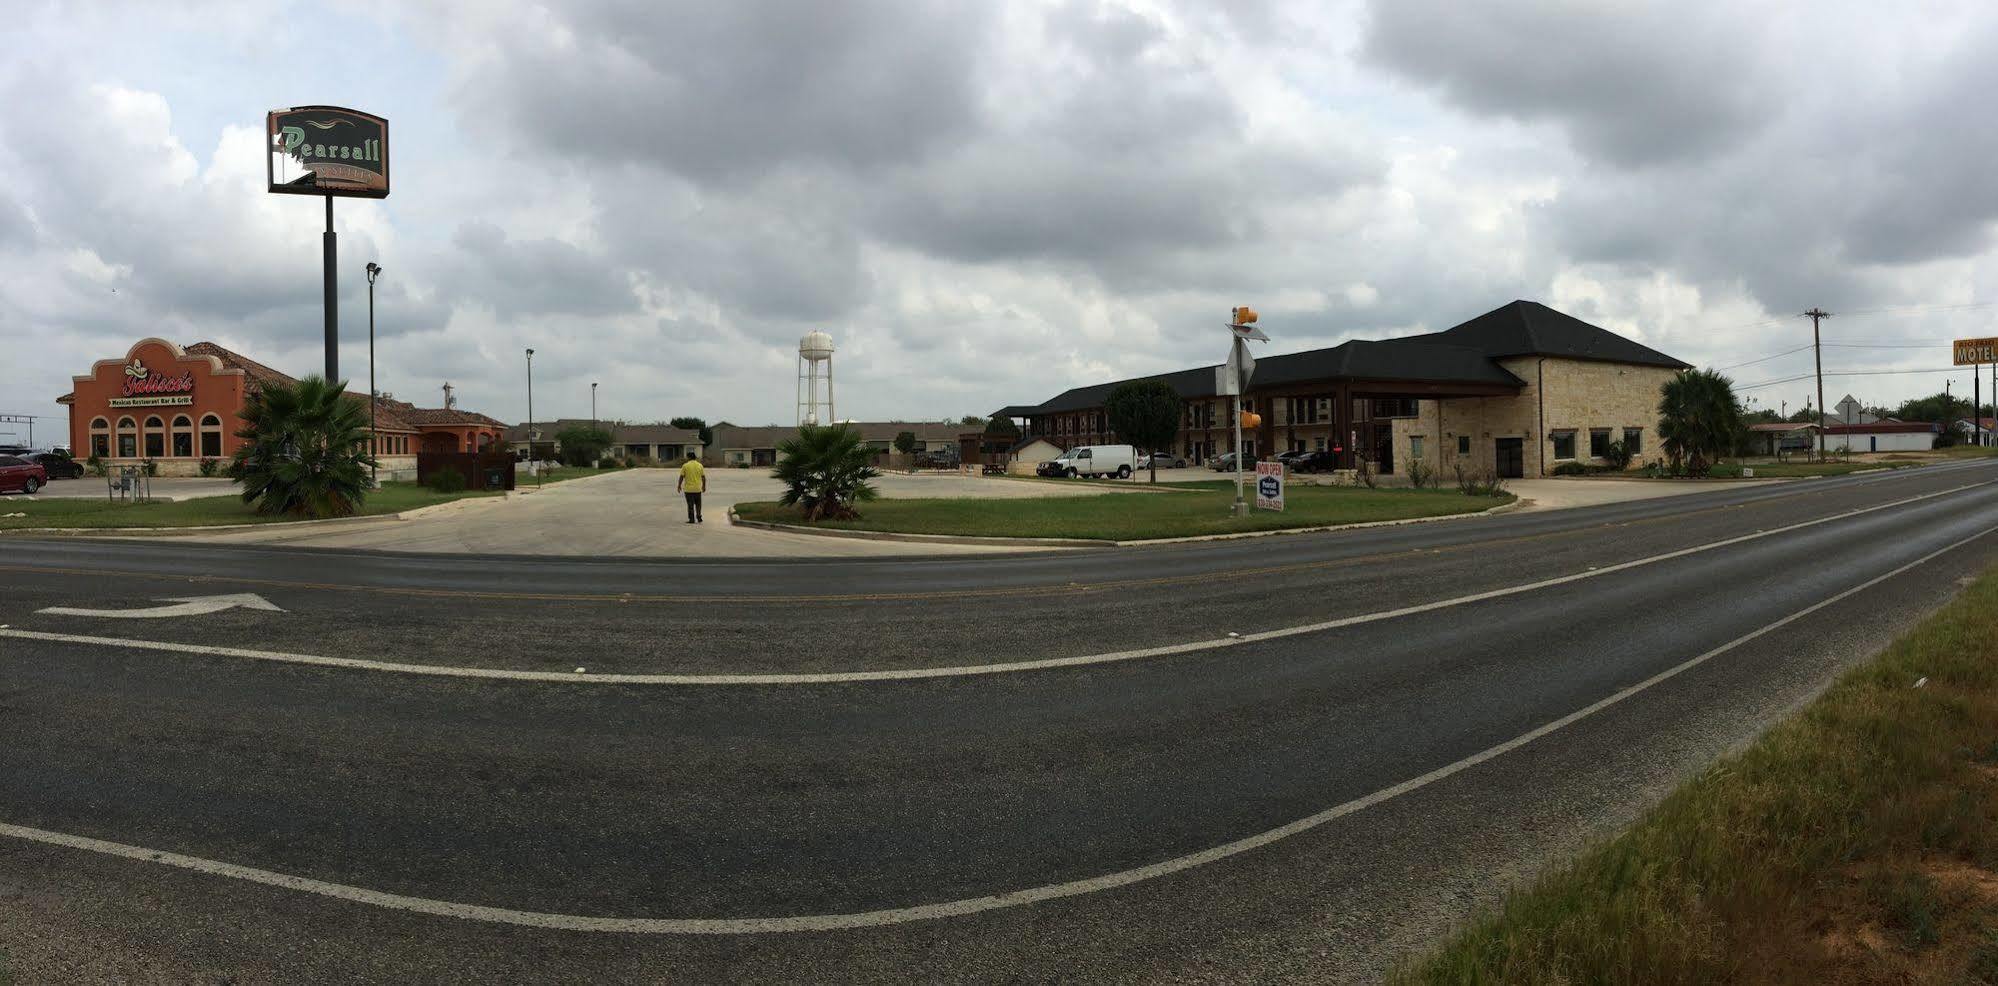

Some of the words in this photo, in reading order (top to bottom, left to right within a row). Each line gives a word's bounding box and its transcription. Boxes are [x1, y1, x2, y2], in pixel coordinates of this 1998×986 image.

[281, 126, 380, 161] Pearsall
[1957, 346, 1997, 362] MOTEL
[123, 371, 193, 397] Jalisco's
[1256, 463, 1269, 475] NOW
[1269, 463, 1282, 476] OPEN
